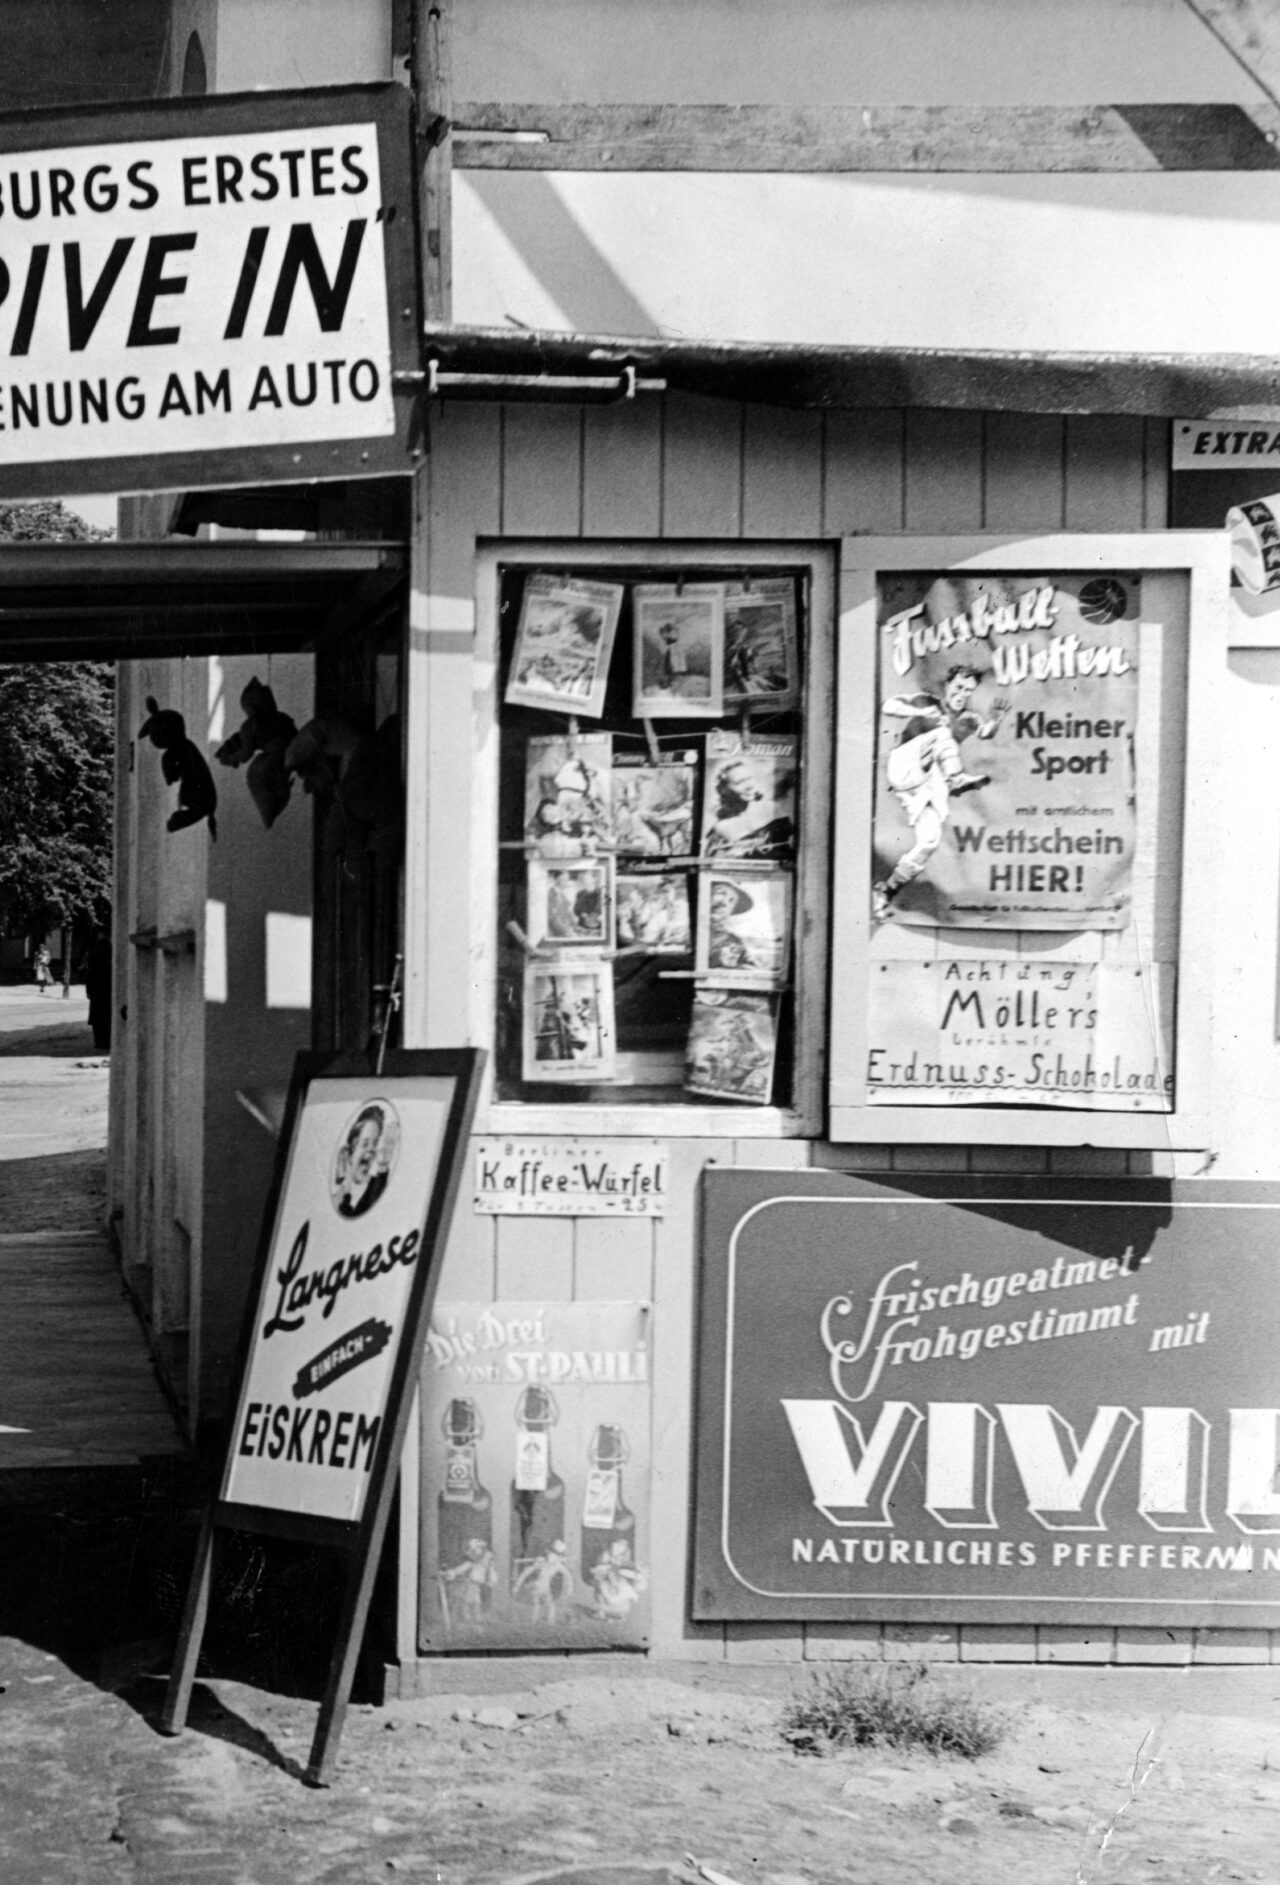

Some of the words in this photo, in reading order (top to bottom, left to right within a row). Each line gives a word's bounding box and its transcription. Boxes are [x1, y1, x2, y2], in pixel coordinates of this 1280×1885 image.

[181, 145, 370, 206] ERSTES
[222, 217, 368, 340] IN
[158, 368, 233, 418] AM
[247, 358, 380, 411] AUTO
[992, 633, 1133, 687] Wetten
[1016, 711, 1126, 740] Kleiner
[1031, 747, 1110, 781] Sport
[1015, 806, 1038, 816] mit
[953, 825, 1125, 855] Wettschein
[989, 864, 1085, 893] HIER!
[263, 1218, 420, 1340] Langnese
[830, 1294, 1139, 1402] frohgestimmt
[1148, 1311, 1211, 1353] mit
